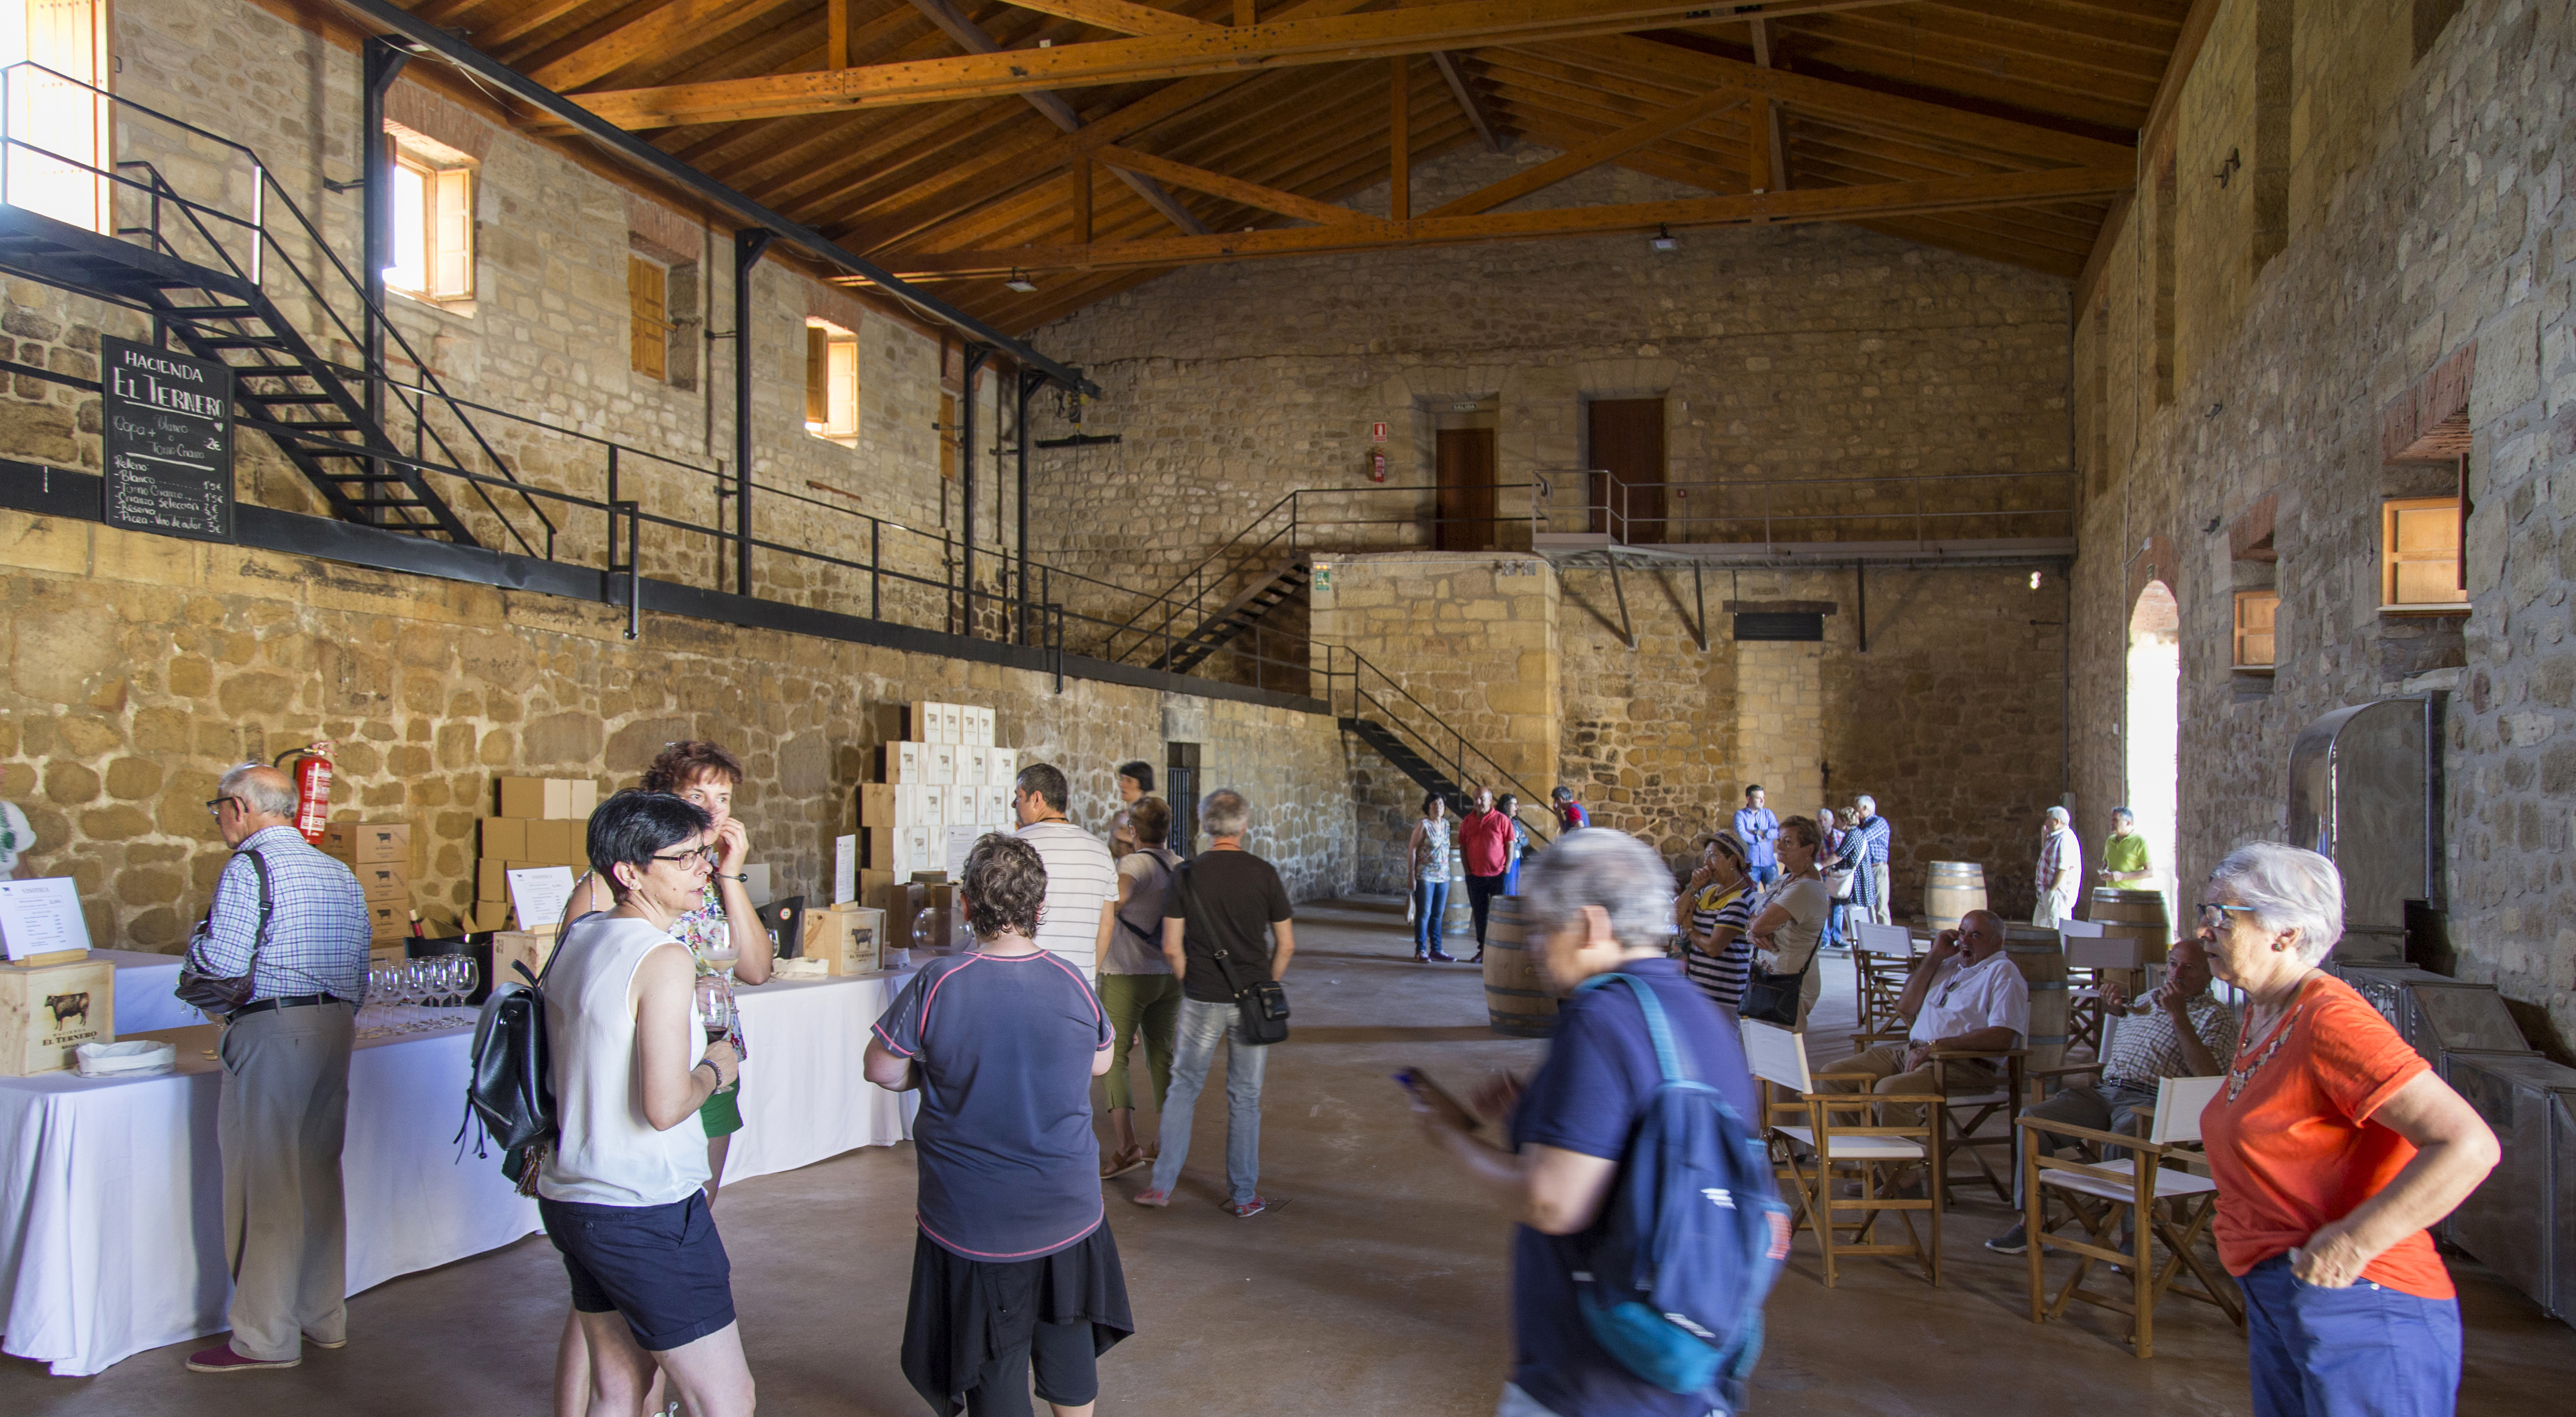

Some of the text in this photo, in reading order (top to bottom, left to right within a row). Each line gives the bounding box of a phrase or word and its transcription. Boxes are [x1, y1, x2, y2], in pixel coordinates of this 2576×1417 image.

[124, 350, 203, 383] HACIENDA
[113, 366, 225, 418] EL TERNERO
[114, 415, 145, 440] Copa
[153, 414, 188, 433] Blanco
[56, 1031, 97, 1043] TERNERO
